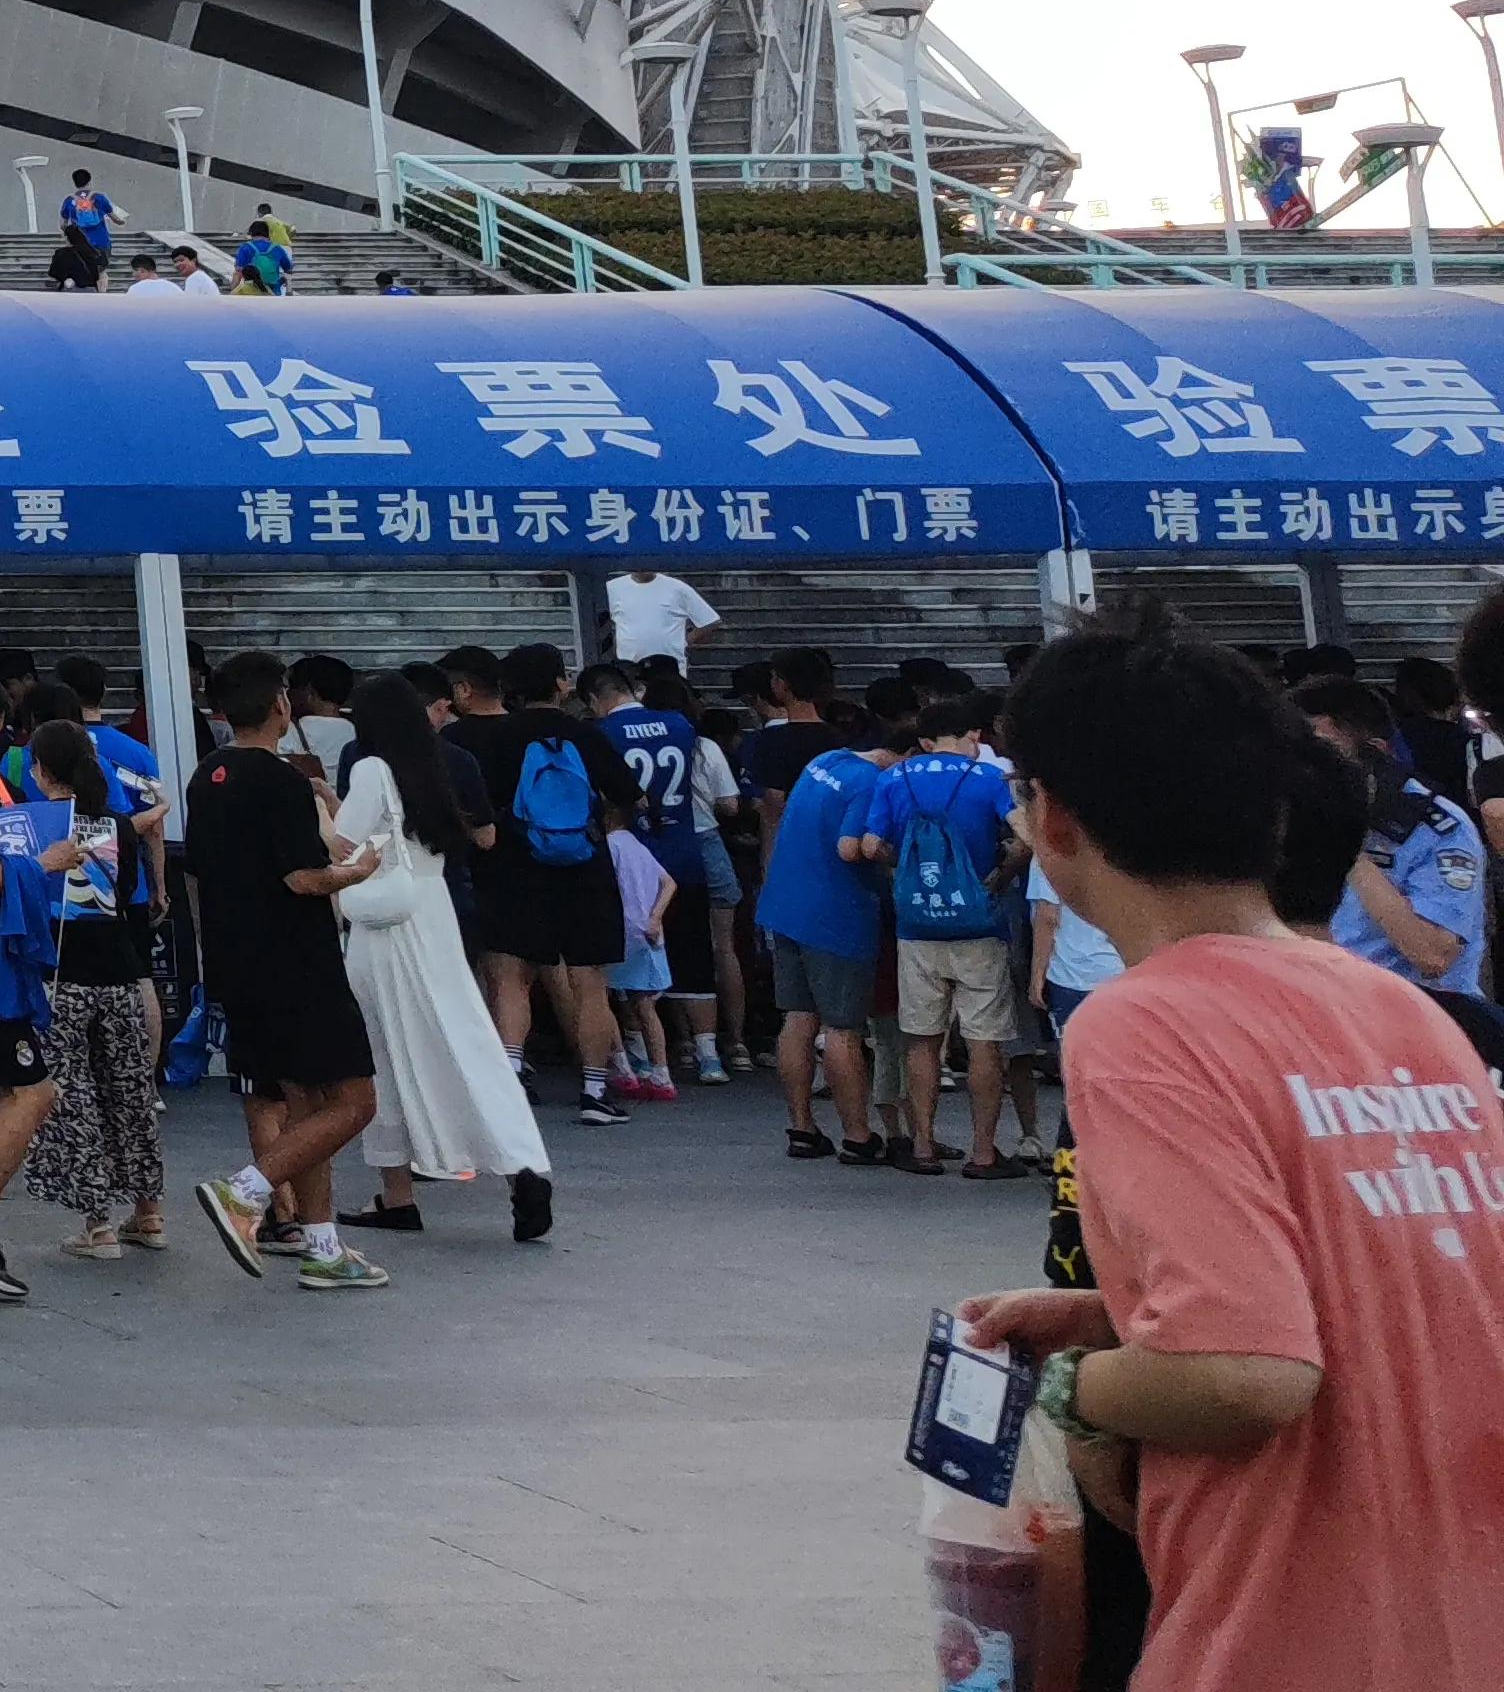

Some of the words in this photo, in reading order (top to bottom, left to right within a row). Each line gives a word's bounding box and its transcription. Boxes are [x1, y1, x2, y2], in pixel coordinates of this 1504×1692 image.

[188, 358, 919, 458] 验票处
[1064, 356, 1504, 457] 验票
[240, 486, 979, 544] 请主动出示身份证、门票
[622, 721, 669, 739] ZIYECH
[624, 745, 685, 806] 22
[1284, 1065, 1484, 1146] Inspire
